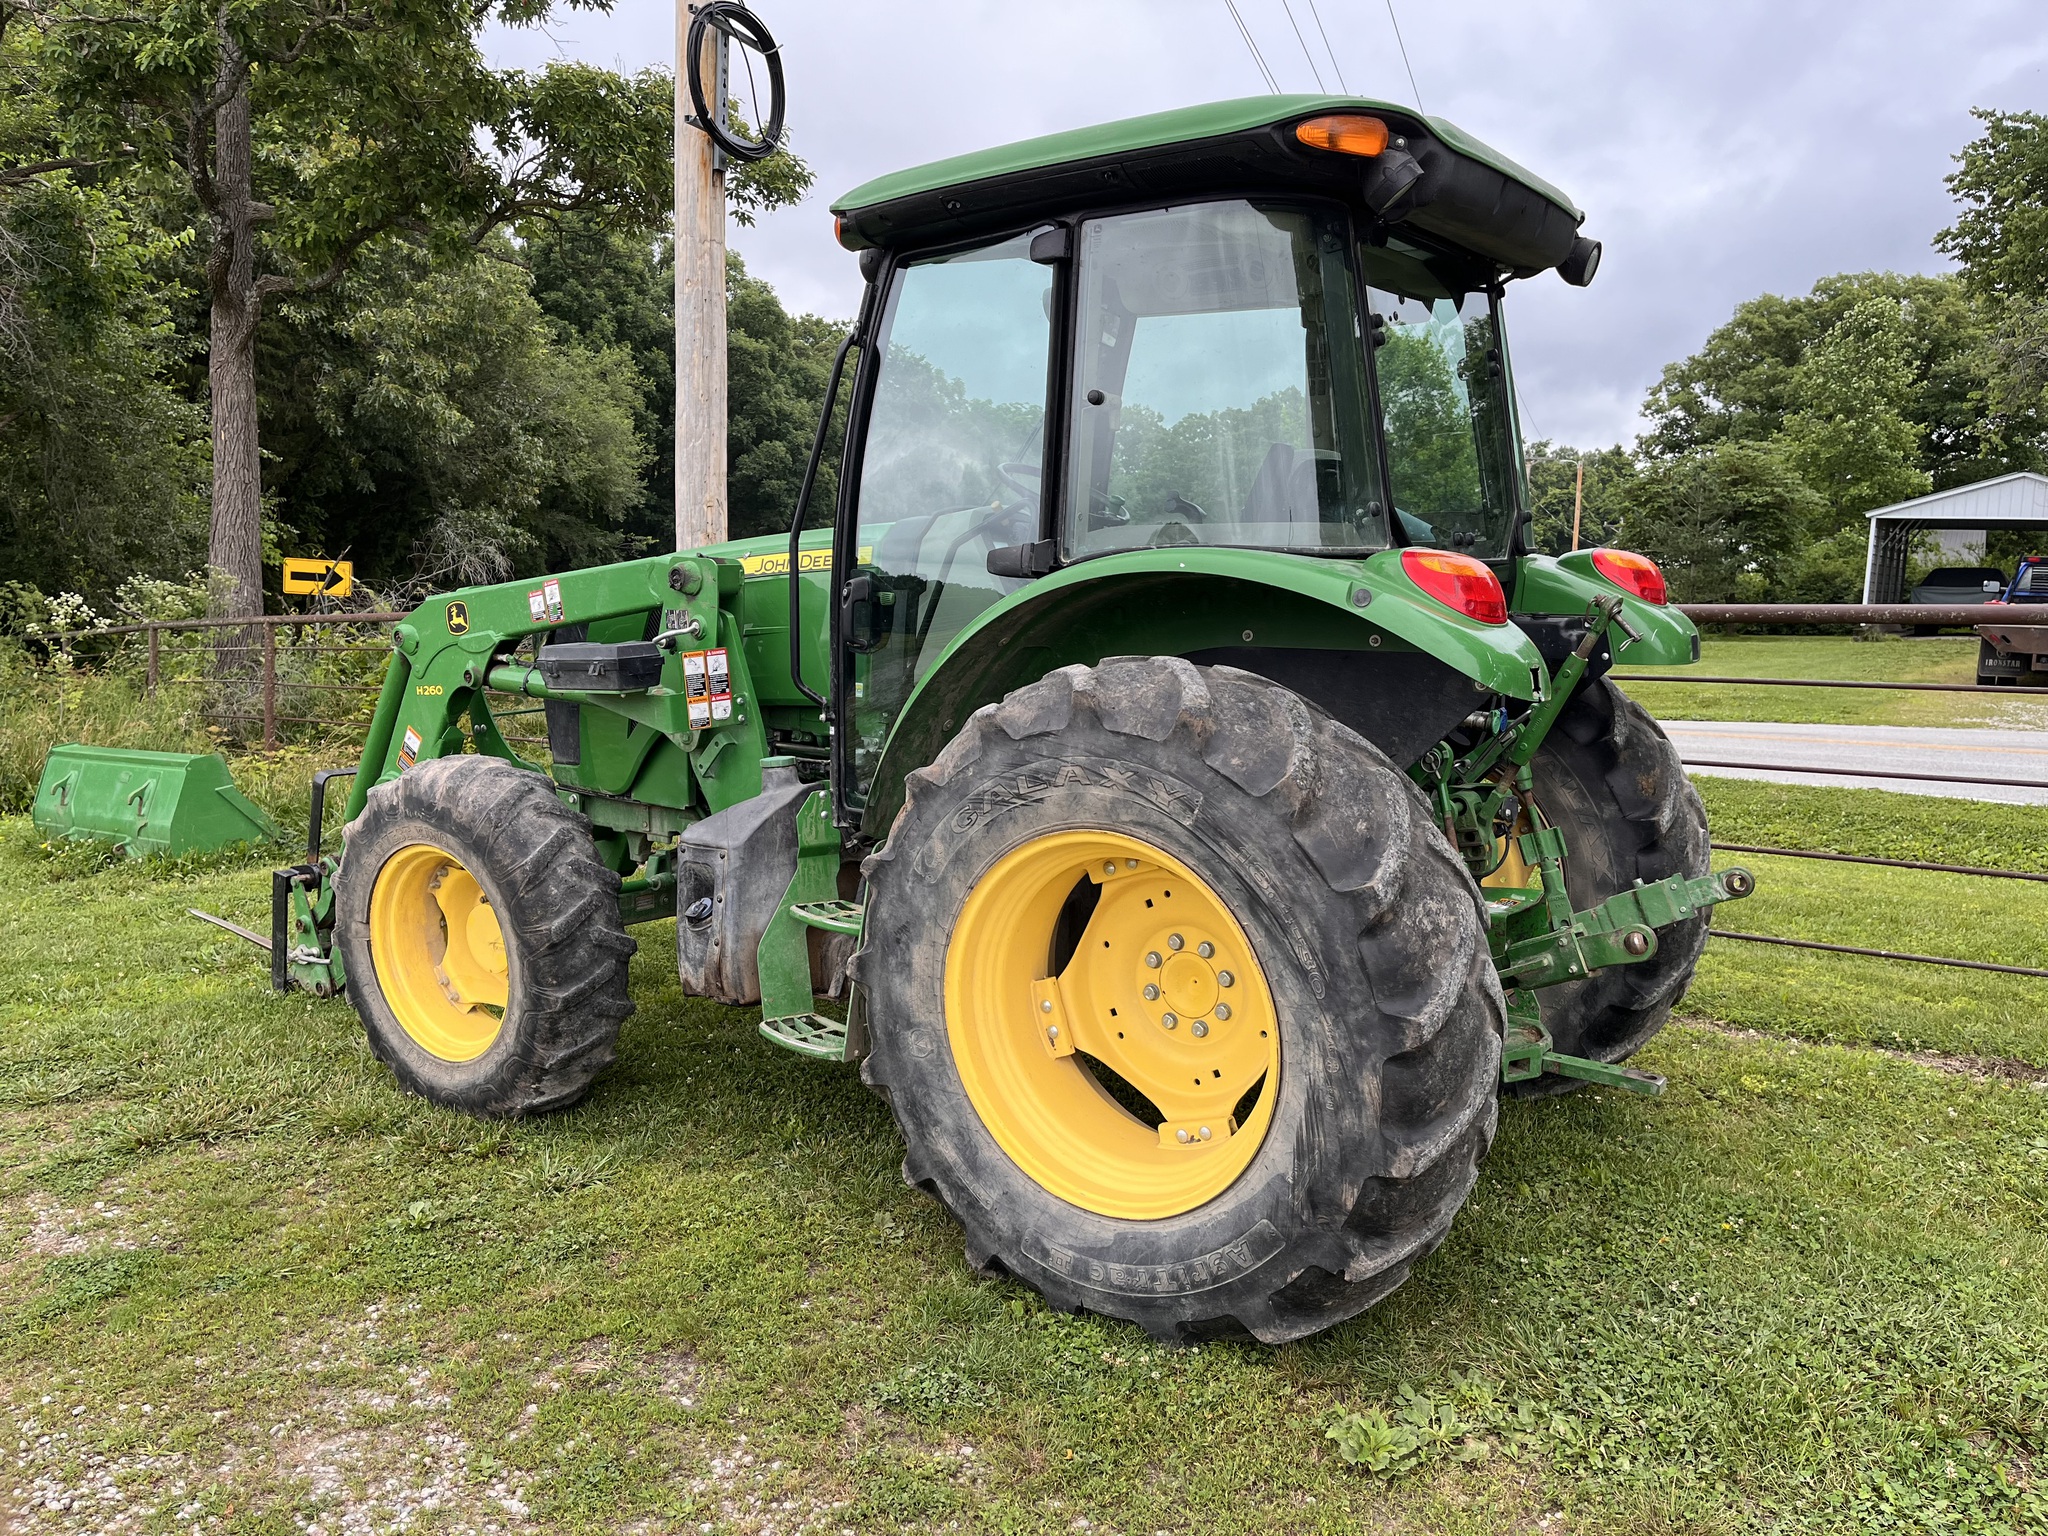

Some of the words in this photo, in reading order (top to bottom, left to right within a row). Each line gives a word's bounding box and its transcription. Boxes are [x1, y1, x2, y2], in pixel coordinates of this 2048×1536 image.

[799, 554, 833, 569] DEE
[1985, 658, 2021, 667] IRONSTAR
[416, 685, 443, 696] H260
[950, 763, 1187, 834] GALAXY
[1048, 1246, 1074, 1275] II
[1089, 1239, 1257, 1294] AgriTrac
